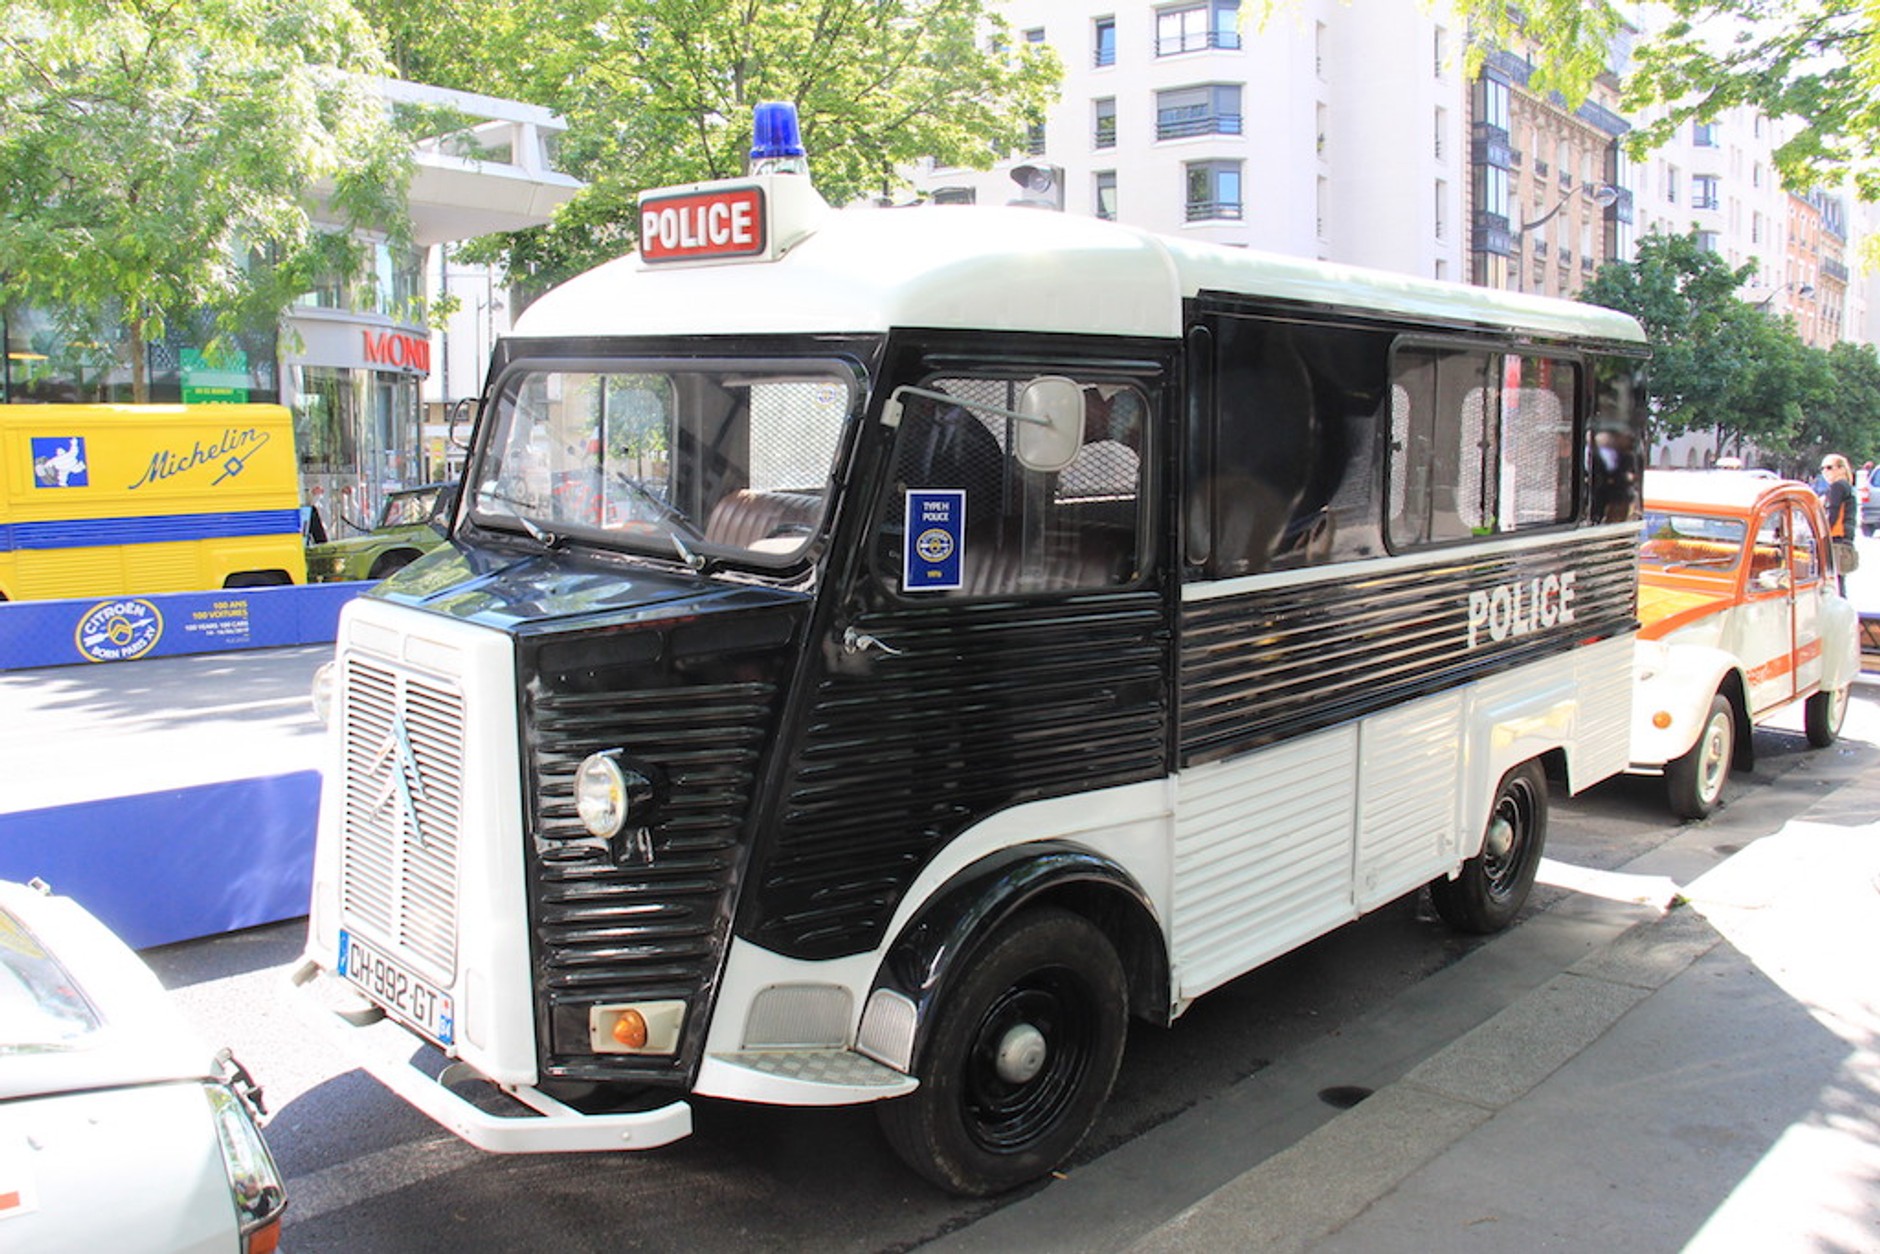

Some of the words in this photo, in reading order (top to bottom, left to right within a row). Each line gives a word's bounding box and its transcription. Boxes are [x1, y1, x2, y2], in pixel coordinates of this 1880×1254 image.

[642, 201, 752, 251] POLICE
[128, 428, 269, 490] Michelin
[922, 512, 949, 522] POLICE
[1467, 571, 1576, 649] POLICE
[350, 943, 438, 1027] CH-992-GT
